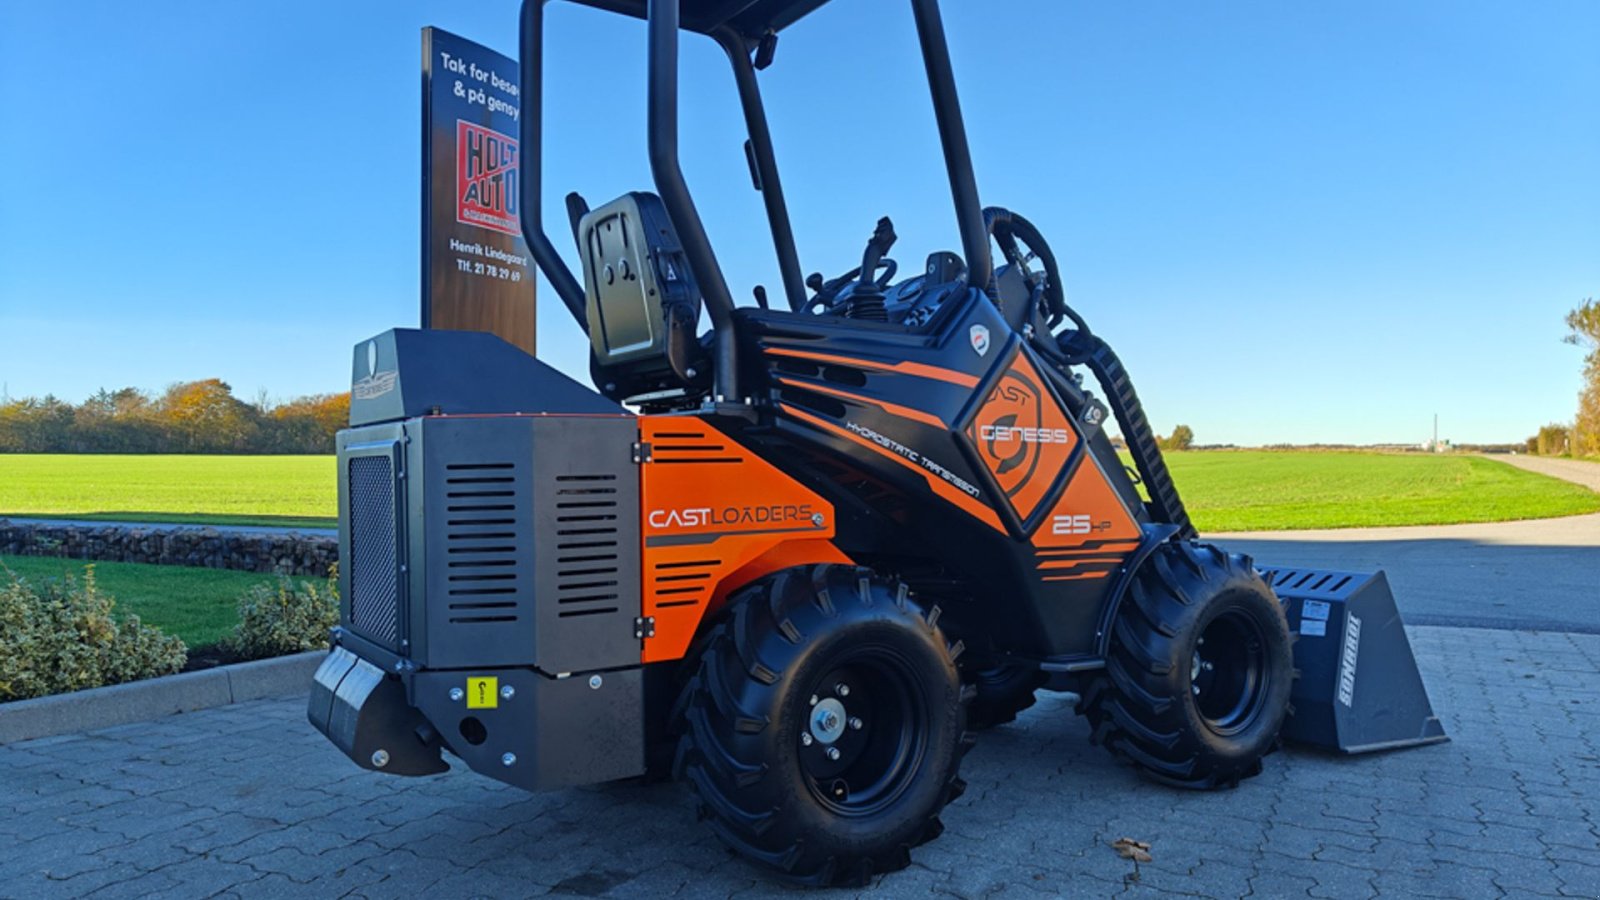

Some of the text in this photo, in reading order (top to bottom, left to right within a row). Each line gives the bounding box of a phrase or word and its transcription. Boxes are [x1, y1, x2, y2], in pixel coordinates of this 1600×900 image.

[441, 52, 519, 96] Tak for besø
[453, 80, 466, 98] &
[468, 88, 485, 104] på
[466, 128, 517, 180] HOLT
[463, 167, 518, 216] AUTO
[449, 239, 483, 256] Henrik
[474, 262, 484, 275] 21
[486, 264, 497, 277] 78
[499, 267, 510, 280] 29
[846, 421, 919, 462] HYDROSTATIC
[980, 424, 1068, 444] GENESIS
